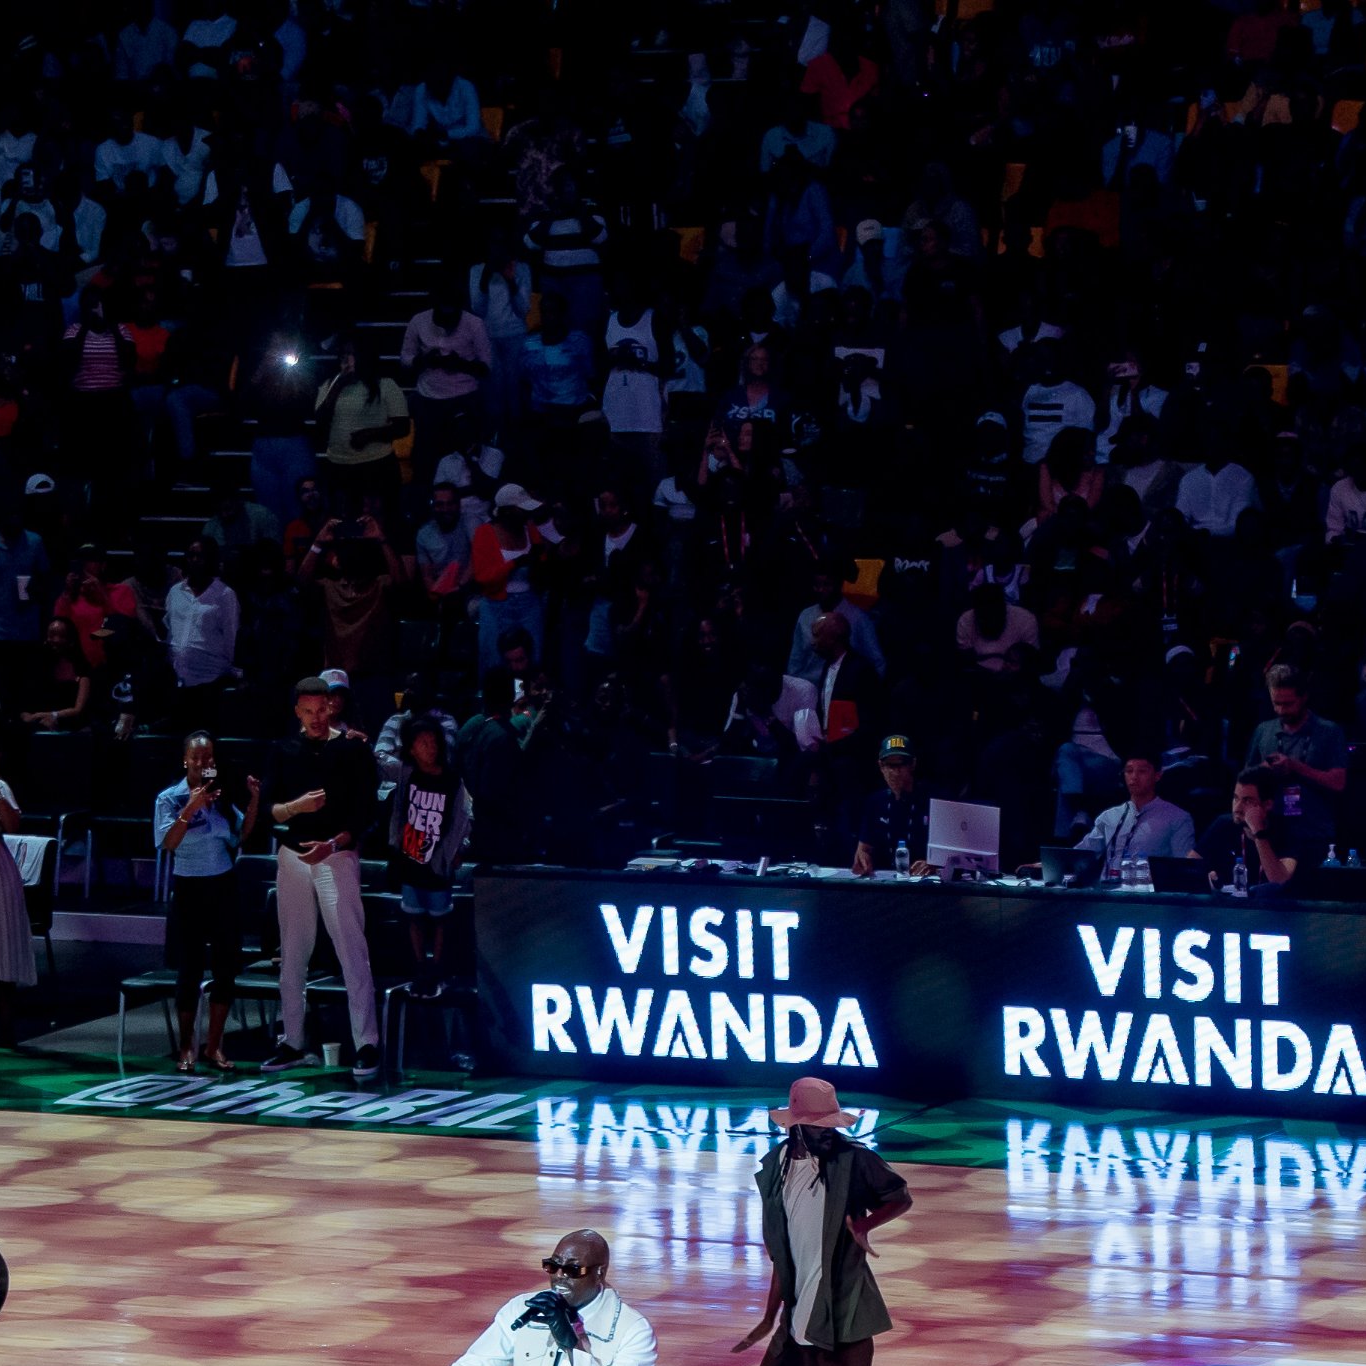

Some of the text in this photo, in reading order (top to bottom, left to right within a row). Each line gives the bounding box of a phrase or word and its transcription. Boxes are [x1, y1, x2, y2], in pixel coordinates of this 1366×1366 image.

[599, 903, 799, 980] VISIT
[1077, 924, 1290, 1006] VISIT
[531, 983, 879, 1068] RWANDA
[53, 1074, 572, 1131] @theBAL
